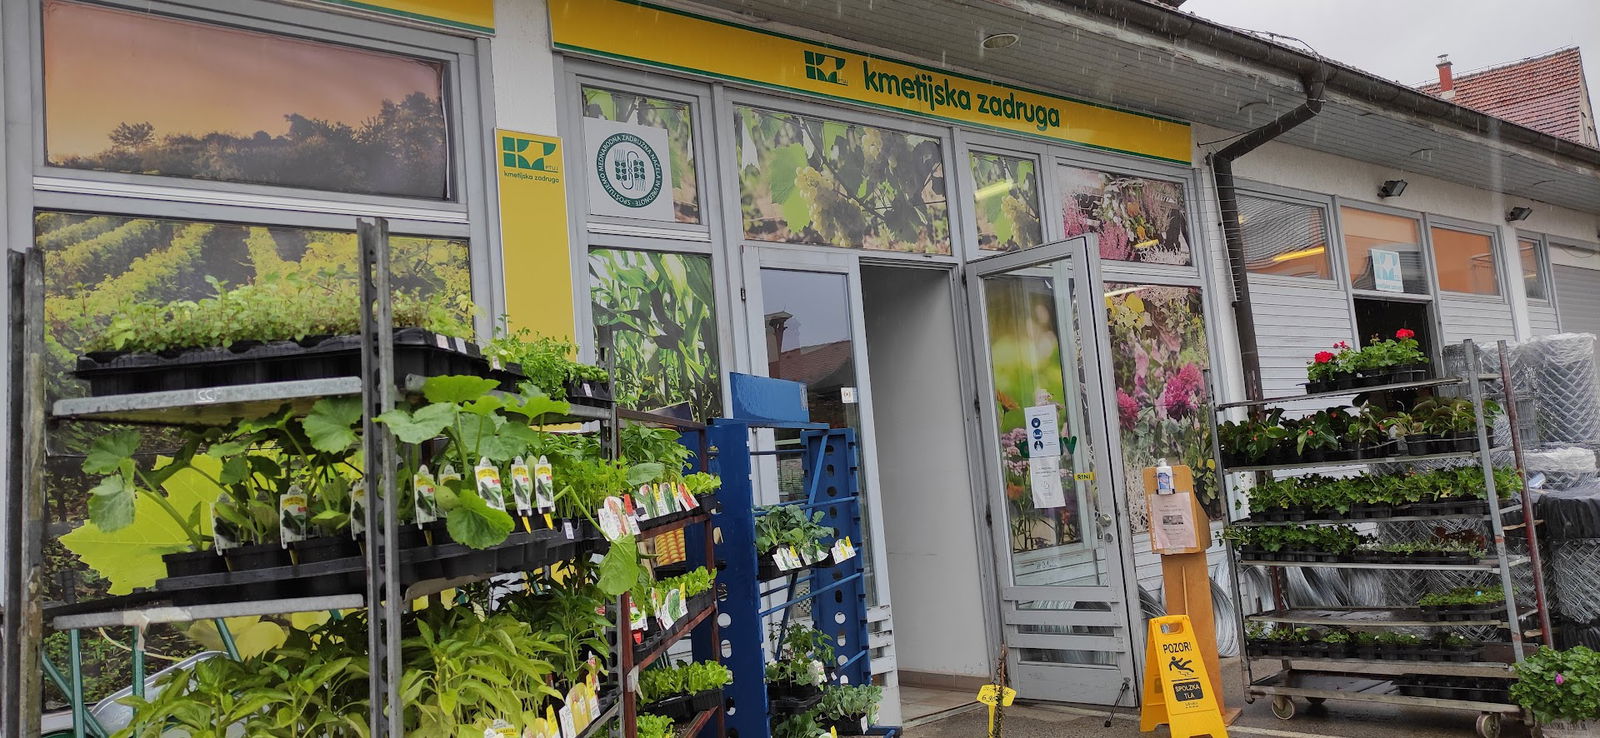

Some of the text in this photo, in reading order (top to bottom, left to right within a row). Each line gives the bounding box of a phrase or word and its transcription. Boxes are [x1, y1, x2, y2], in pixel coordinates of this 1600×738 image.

[863, 61, 1060, 132] kmetijska zadruga
[597, 136, 621, 172] MEDNARODNA
[503, 170, 560, 184] kmetijska zadruga
[1162, 641, 1193, 654] POZOR!
[1175, 683, 1200, 693] SPOLZKA
[1184, 692, 1195, 700] TLA
